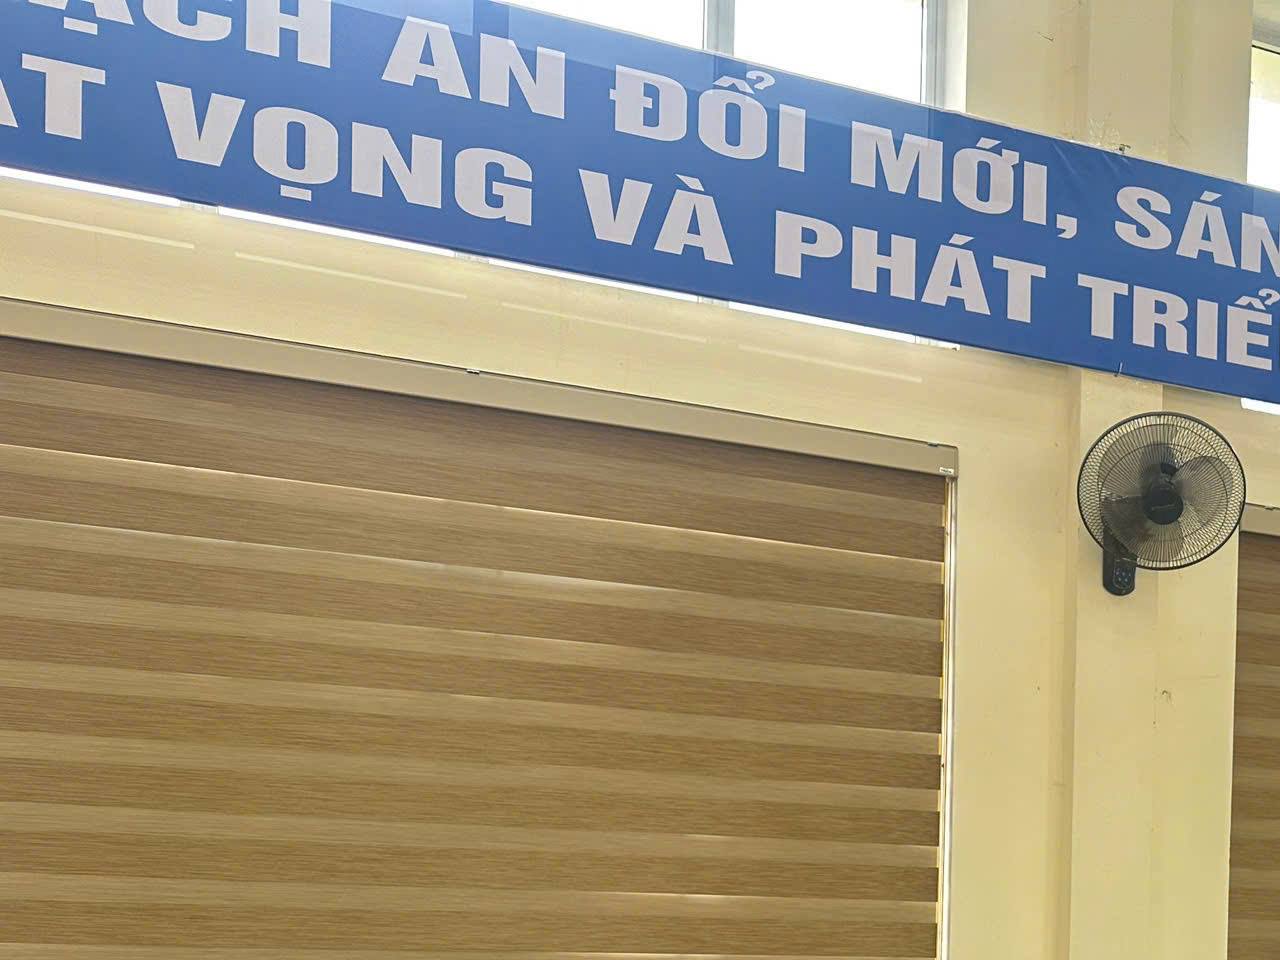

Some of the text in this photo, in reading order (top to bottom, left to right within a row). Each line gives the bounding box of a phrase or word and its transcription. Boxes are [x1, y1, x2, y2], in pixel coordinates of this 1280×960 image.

[0, 53, 106, 140] T
[155, 81, 533, 227] VỌNG
[578, 169, 735, 266] VÀ
[774, 210, 1047, 324] PHÁT
[28, 0, 331, 68] CH
[382, 17, 566, 119] AN
[610, 65, 807, 172] ĐỔI
[850, 121, 1078, 239] MỚI,
